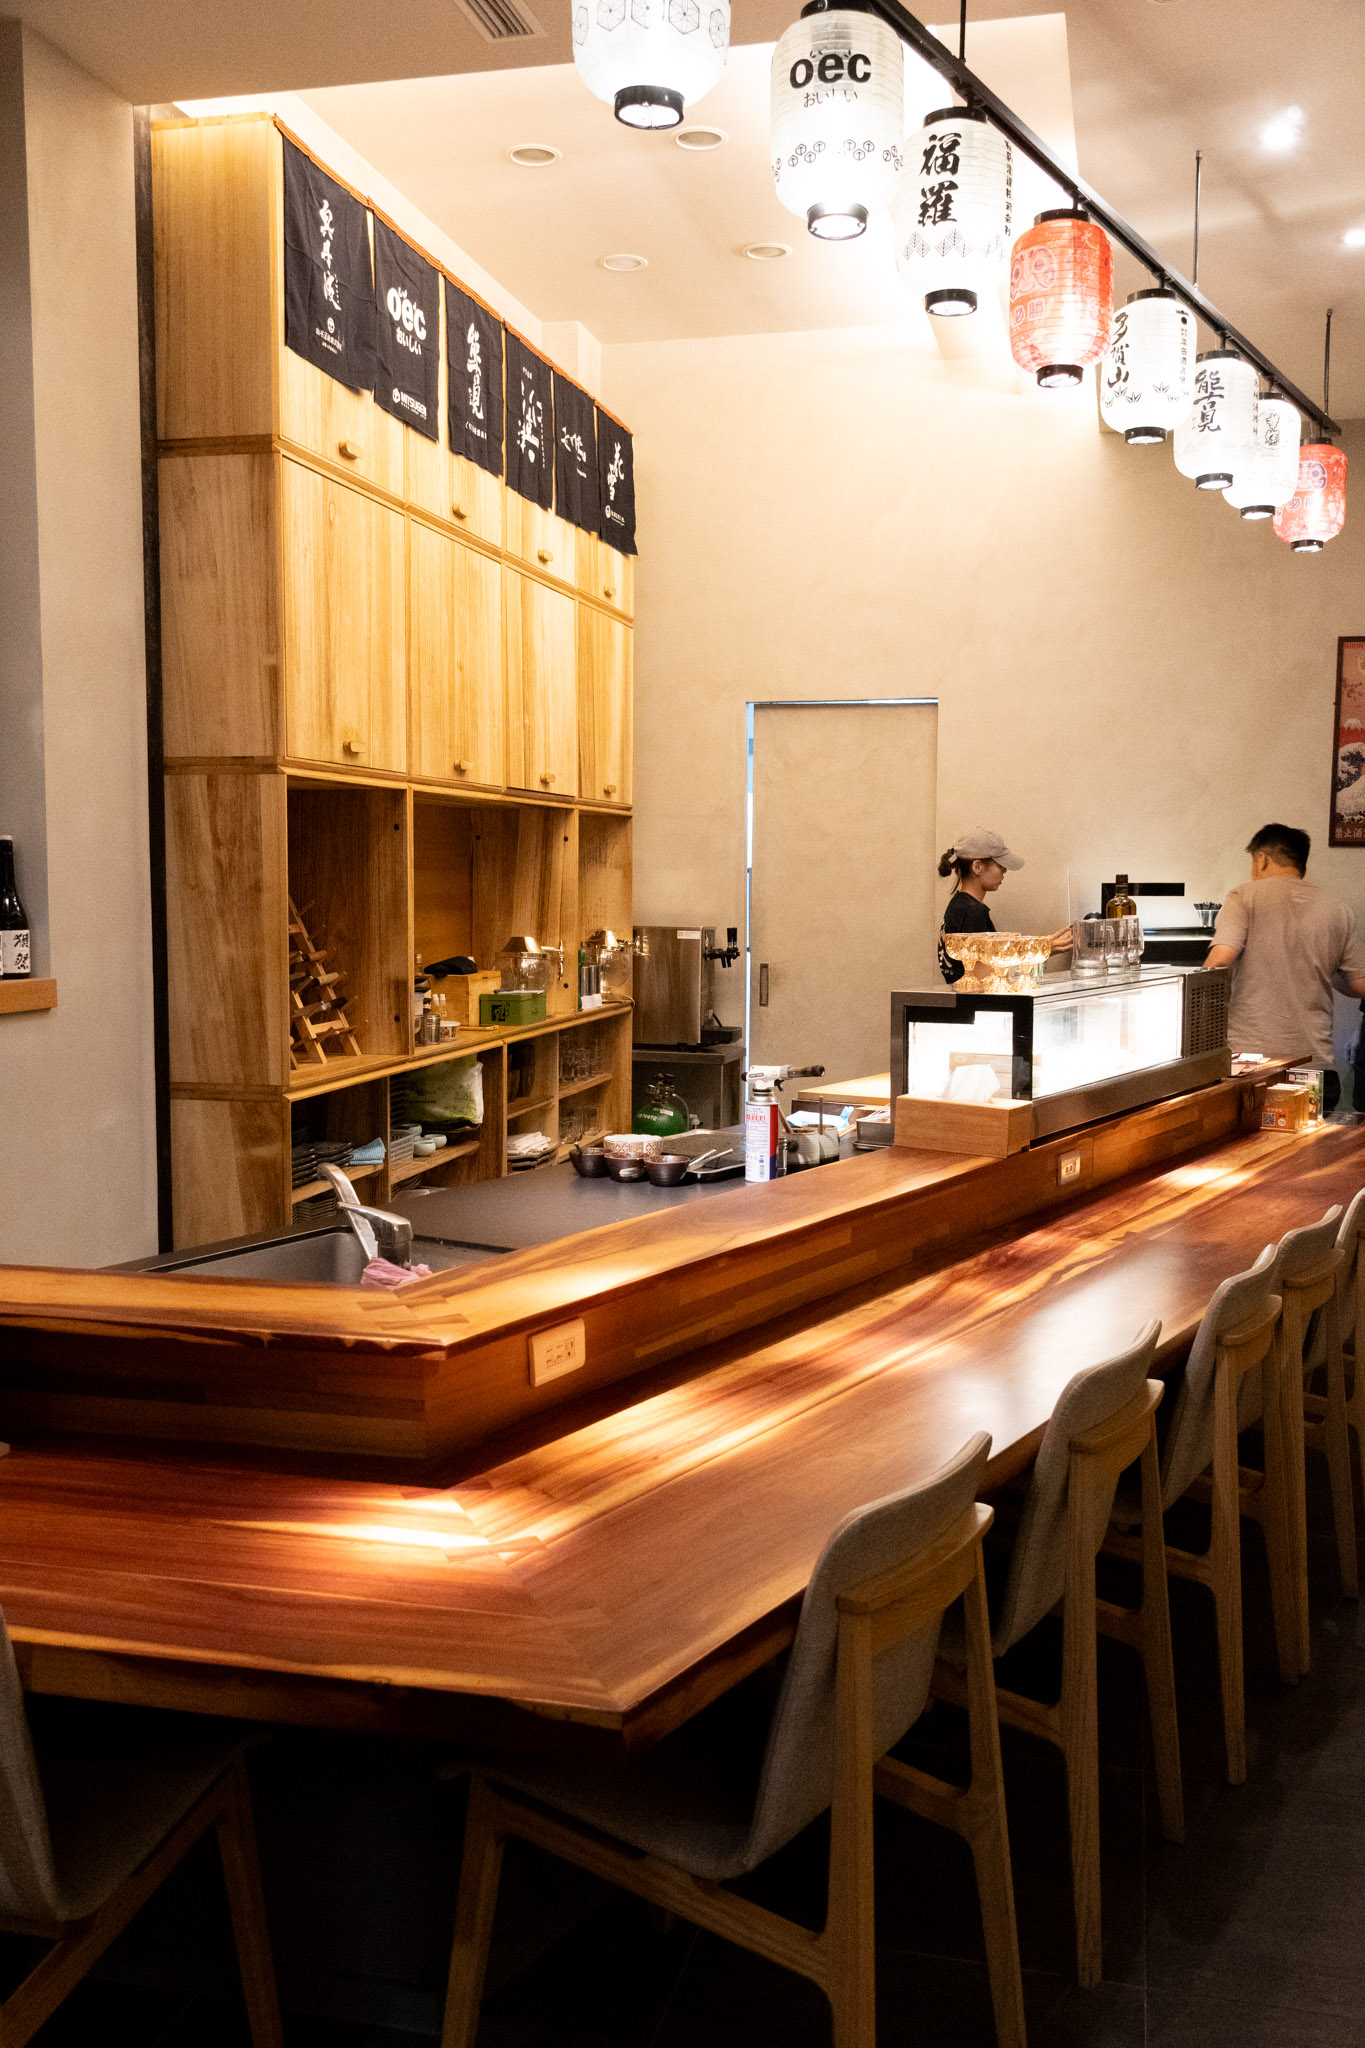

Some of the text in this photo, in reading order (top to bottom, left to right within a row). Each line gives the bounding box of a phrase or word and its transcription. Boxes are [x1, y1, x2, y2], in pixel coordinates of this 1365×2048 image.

[789, 53, 872, 89] oec
[803, 88, 858, 107] おいしい
[918, 132, 962, 227] 福羅
[387, 287, 427, 340] oec
[396, 327, 422, 355] おいしい
[1335, 826, 1365, 839] 禁止酒
